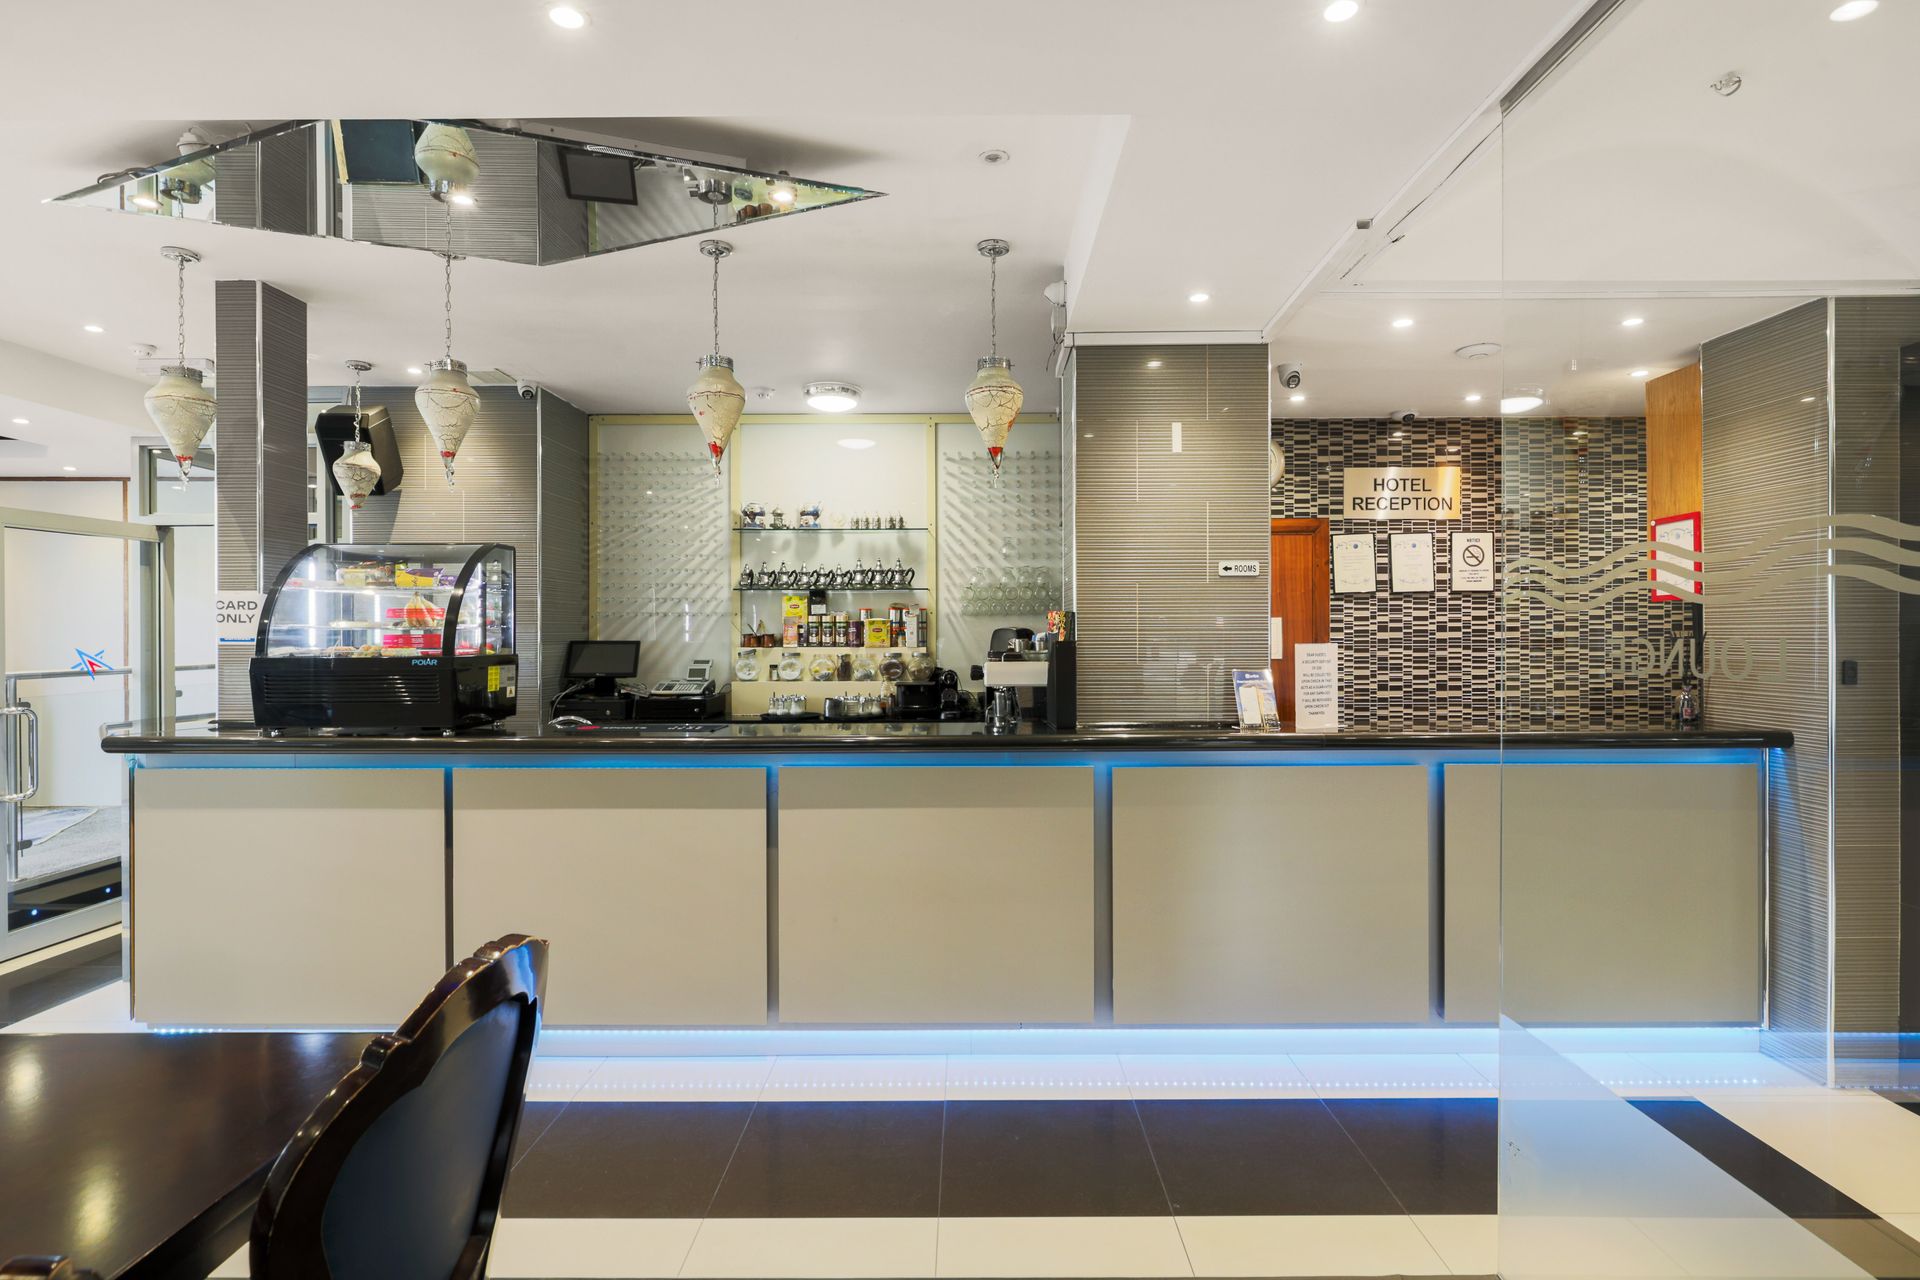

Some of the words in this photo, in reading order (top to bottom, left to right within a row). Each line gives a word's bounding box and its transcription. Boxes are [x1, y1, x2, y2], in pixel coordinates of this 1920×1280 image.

[1373, 478, 1432, 492] HOTEL
[1352, 496, 1453, 511] RECEPTION
[1234, 564, 1257, 573] ROOMS
[216, 600, 258, 610] CARD
[216, 613, 256, 623] ONLY
[411, 658, 438, 666] POLAR
